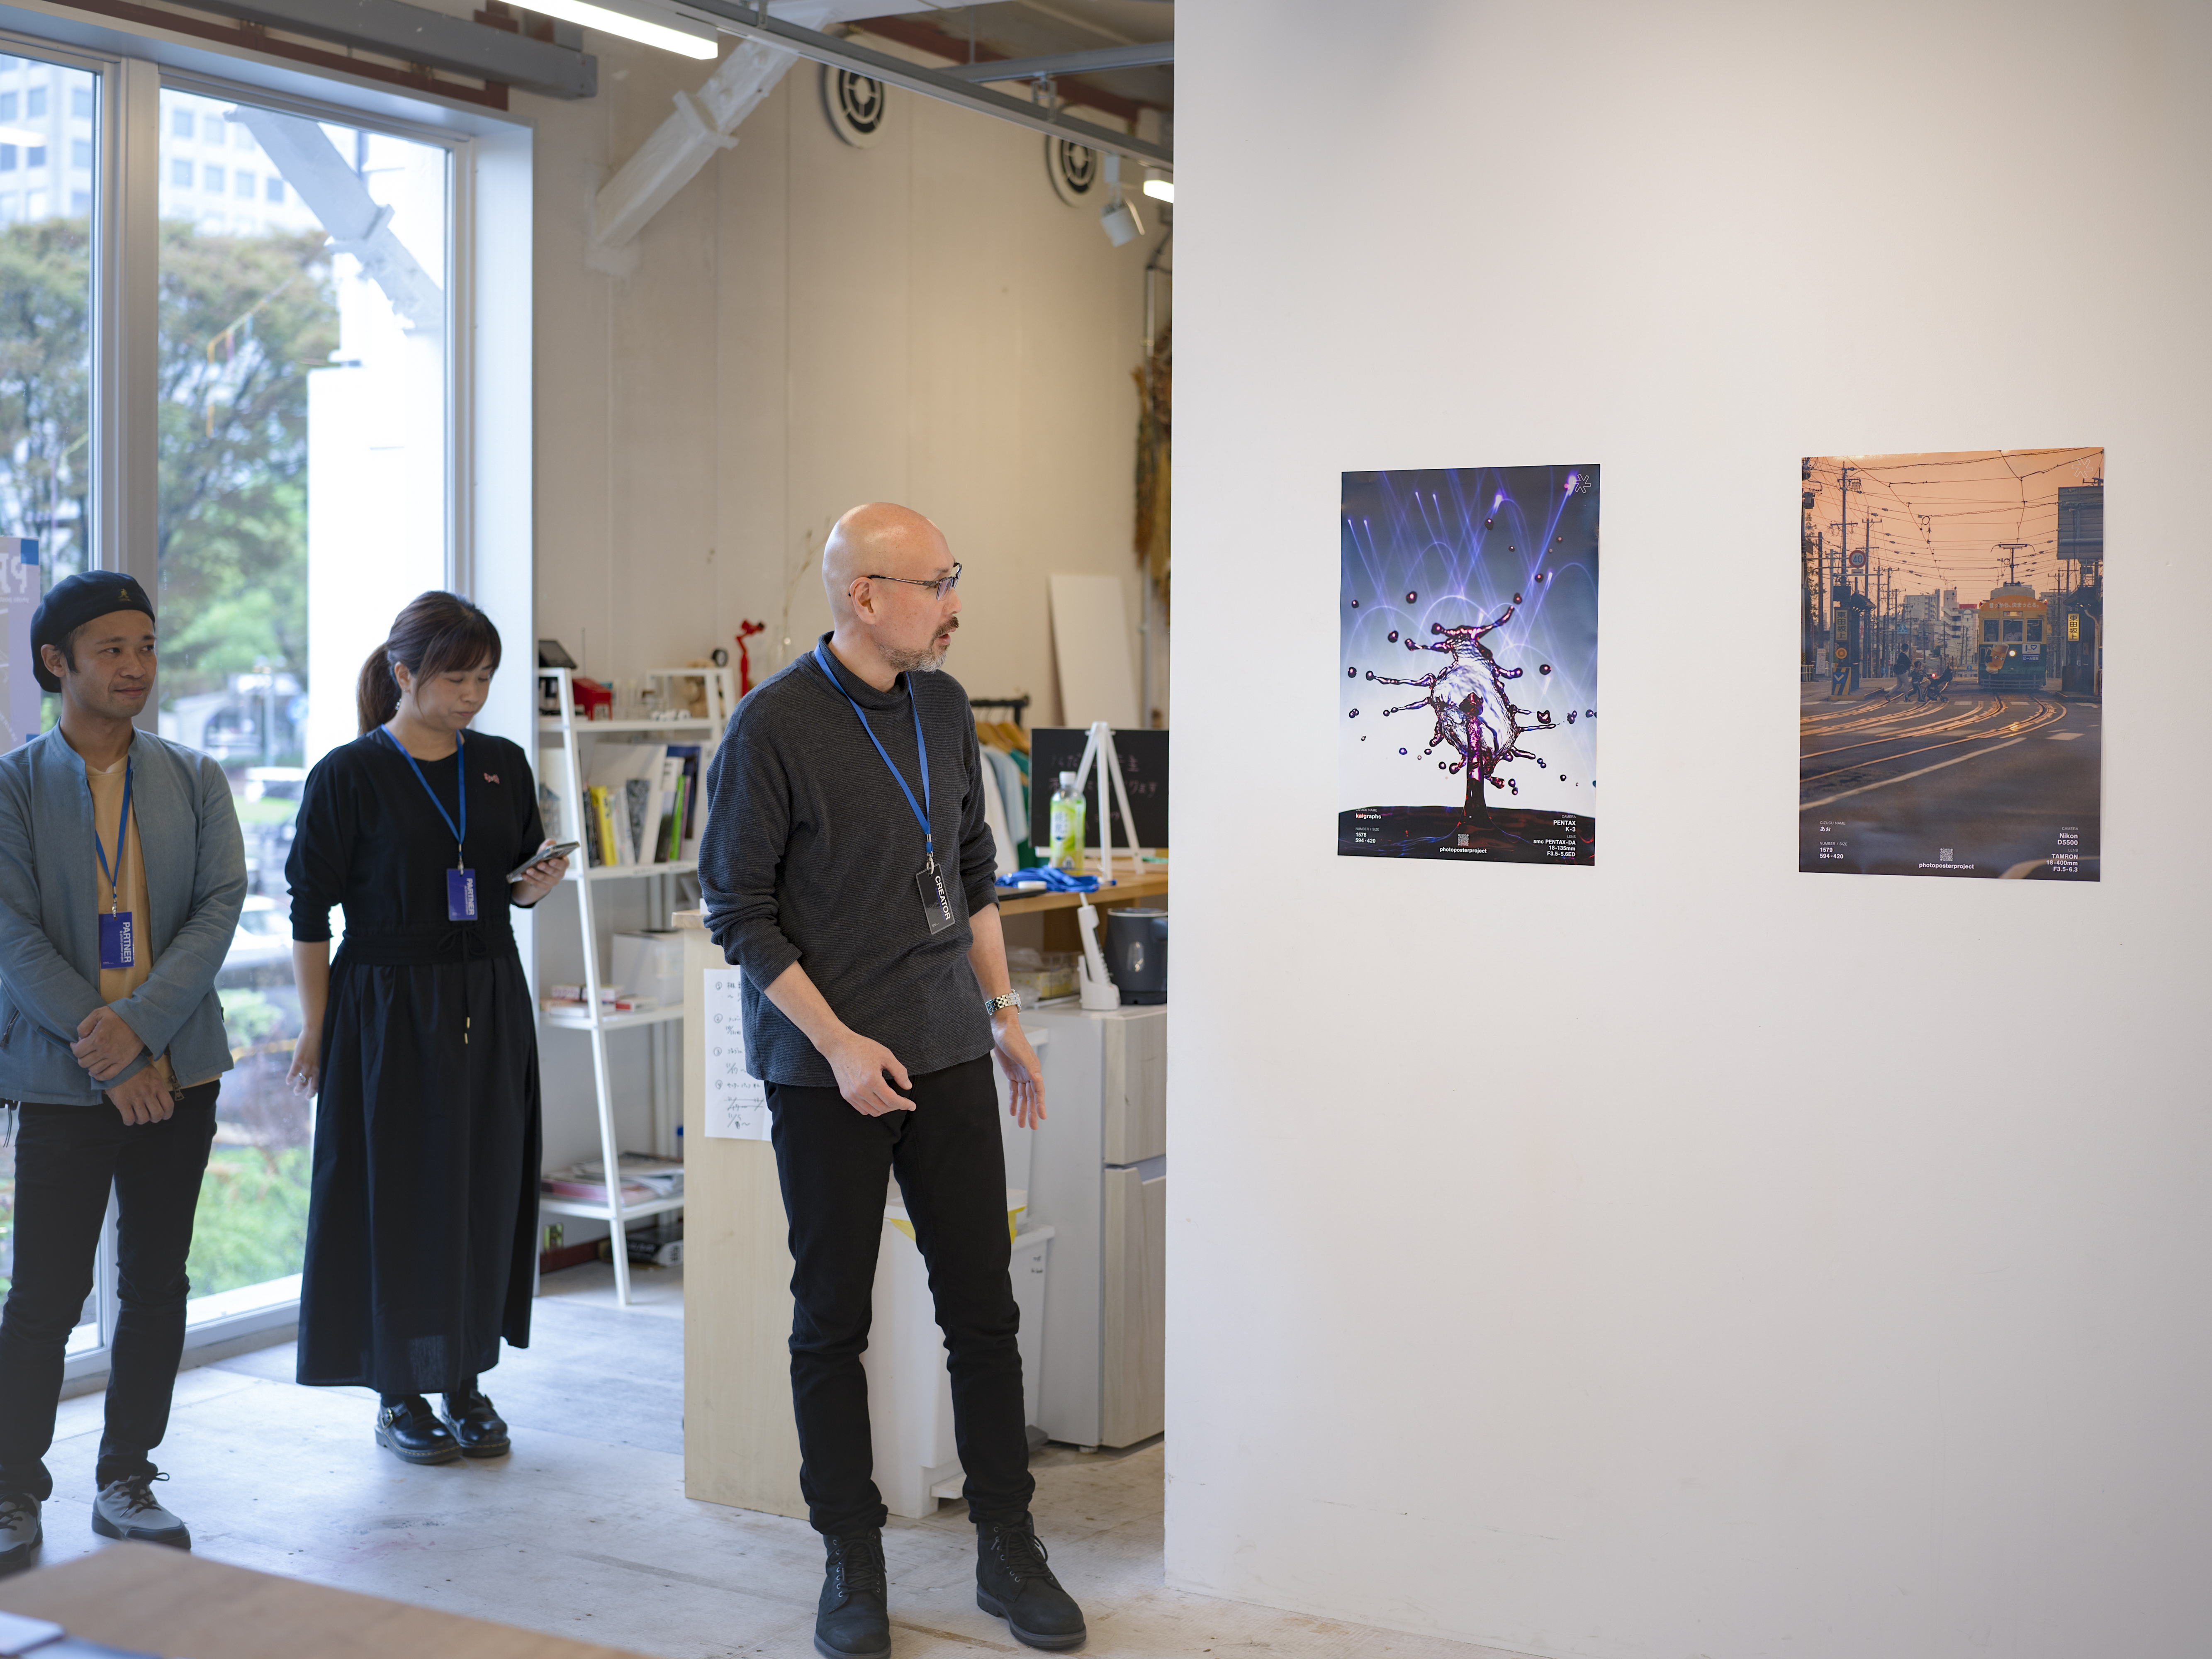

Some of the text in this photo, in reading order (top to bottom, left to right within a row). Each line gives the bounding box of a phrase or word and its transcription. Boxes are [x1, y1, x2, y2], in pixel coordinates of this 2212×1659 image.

[1837, 611, 1846, 639] 東田坂上
[2069, 615, 2078, 640] 東田坂上
[935, 876, 951, 920] CREATOR
[123, 922, 131, 963] PARTNER
